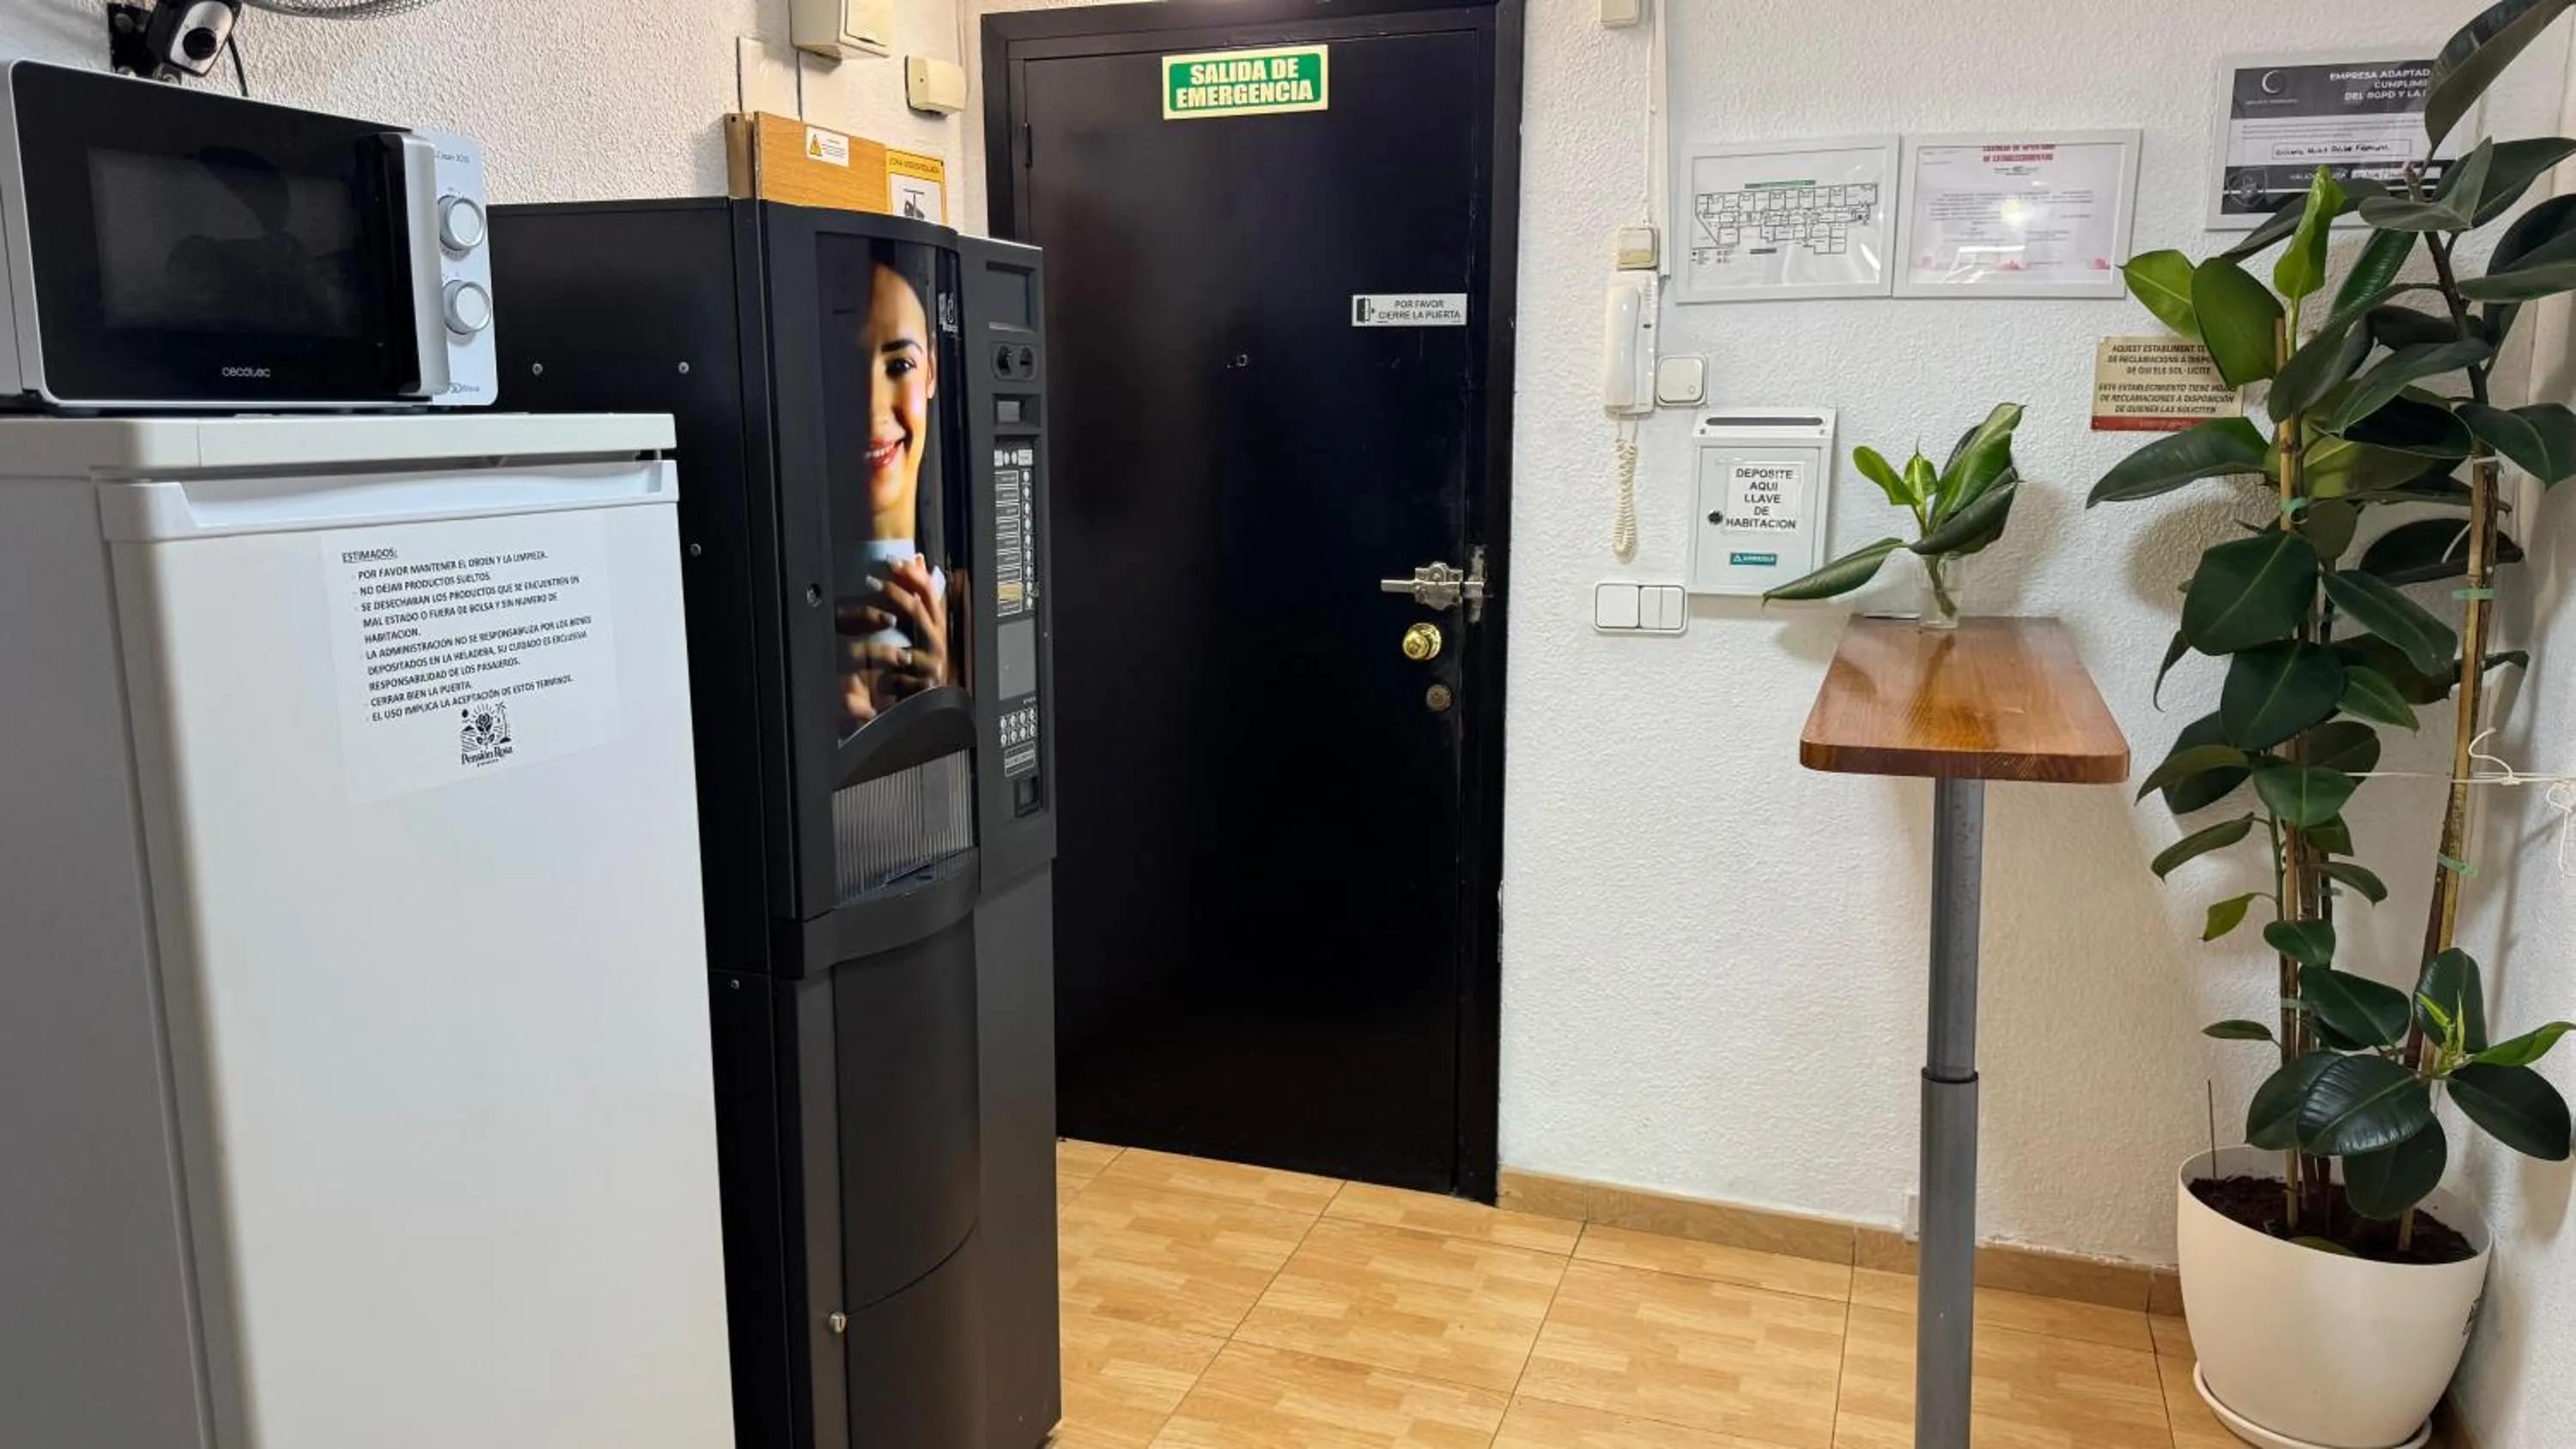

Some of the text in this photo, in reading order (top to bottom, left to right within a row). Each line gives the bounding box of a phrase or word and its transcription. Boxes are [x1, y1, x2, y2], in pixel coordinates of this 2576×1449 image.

[1190, 58, 1298, 85] SALIDA DE
[2330, 69, 2431, 81] EMPRESA ADAPTAD
[1176, 79, 1314, 109] EMERGENCIA
[1394, 300, 1444, 308] POR FAVOR
[1378, 311, 1411, 320] CIERRE
[1425, 310, 1461, 318] PUERTA
[1735, 468, 1794, 479] DEPOSITE
[1749, 482, 1778, 491] AQUI
[1744, 494, 1782, 503] LLAVE
[1754, 506, 1770, 515] DE
[1725, 518, 1796, 529] HABITACION
[342, 548, 398, 562] ESTIMADOS:
[358, 570, 377, 580] POR
[379, 566, 408, 578] FAVOR
[410, 561, 456, 574] MANTENER
[458, 559, 466, 568] EL
[468, 557, 495, 567] ORDEN
[503, 555, 513, 563] LA
[360, 586, 374, 596] NO
[375, 582, 403, 592] DEJAR
[404, 577, 456, 591] PRODUCTOS
[361, 602, 371, 611] SE
[374, 595, 430, 610] DESECHARAN
[432, 593, 447, 603] LOS
[449, 586, 496, 600] PRODUCTOS
[498, 585, 513, 594] QUE
[514, 583, 523, 591] SE
[363, 617, 383, 627] MAL
[385, 612, 418, 625] ESTADO
[420, 610, 428, 620] O
[429, 608, 455, 619] FUERA
[457, 605, 467, 615] DE
[470, 602, 494, 613] BOLSA
[501, 598, 513, 608] SIN
[548, 592, 557, 602] DE
[366, 651, 377, 660] LA
[454, 636, 468, 646] NO
[469, 634, 477, 643] SE
[541, 621, 554, 631] POR
[556, 619, 568, 628] LOS
[570, 616, 592, 626] BIENES
[368, 658, 428, 676] DEPOSITADOS
[429, 656, 440, 664] EN
[442, 654, 452, 664] LA
[498, 645, 507, 653] SU
[508, 639, 541, 652] CUIDADO
[543, 637, 550, 646] ES
[552, 631, 587, 645] EXCLUSIVA
[369, 657, 520, 691] RESPONSABILIDAD DE LOS PASAJEROS.
[371, 693, 405, 706] CERRAR
[407, 689, 428, 700] BIEN
[428, 687, 439, 696] LA
[372, 712, 383, 722] EL
[384, 708, 403, 718] USO
[404, 700, 439, 715] IMPLICA
[440, 698, 451, 708] LA
[501, 686, 512, 696] DE
[513, 682, 535, 694] ESTOS
[494, 746, 513, 757] Rosa
